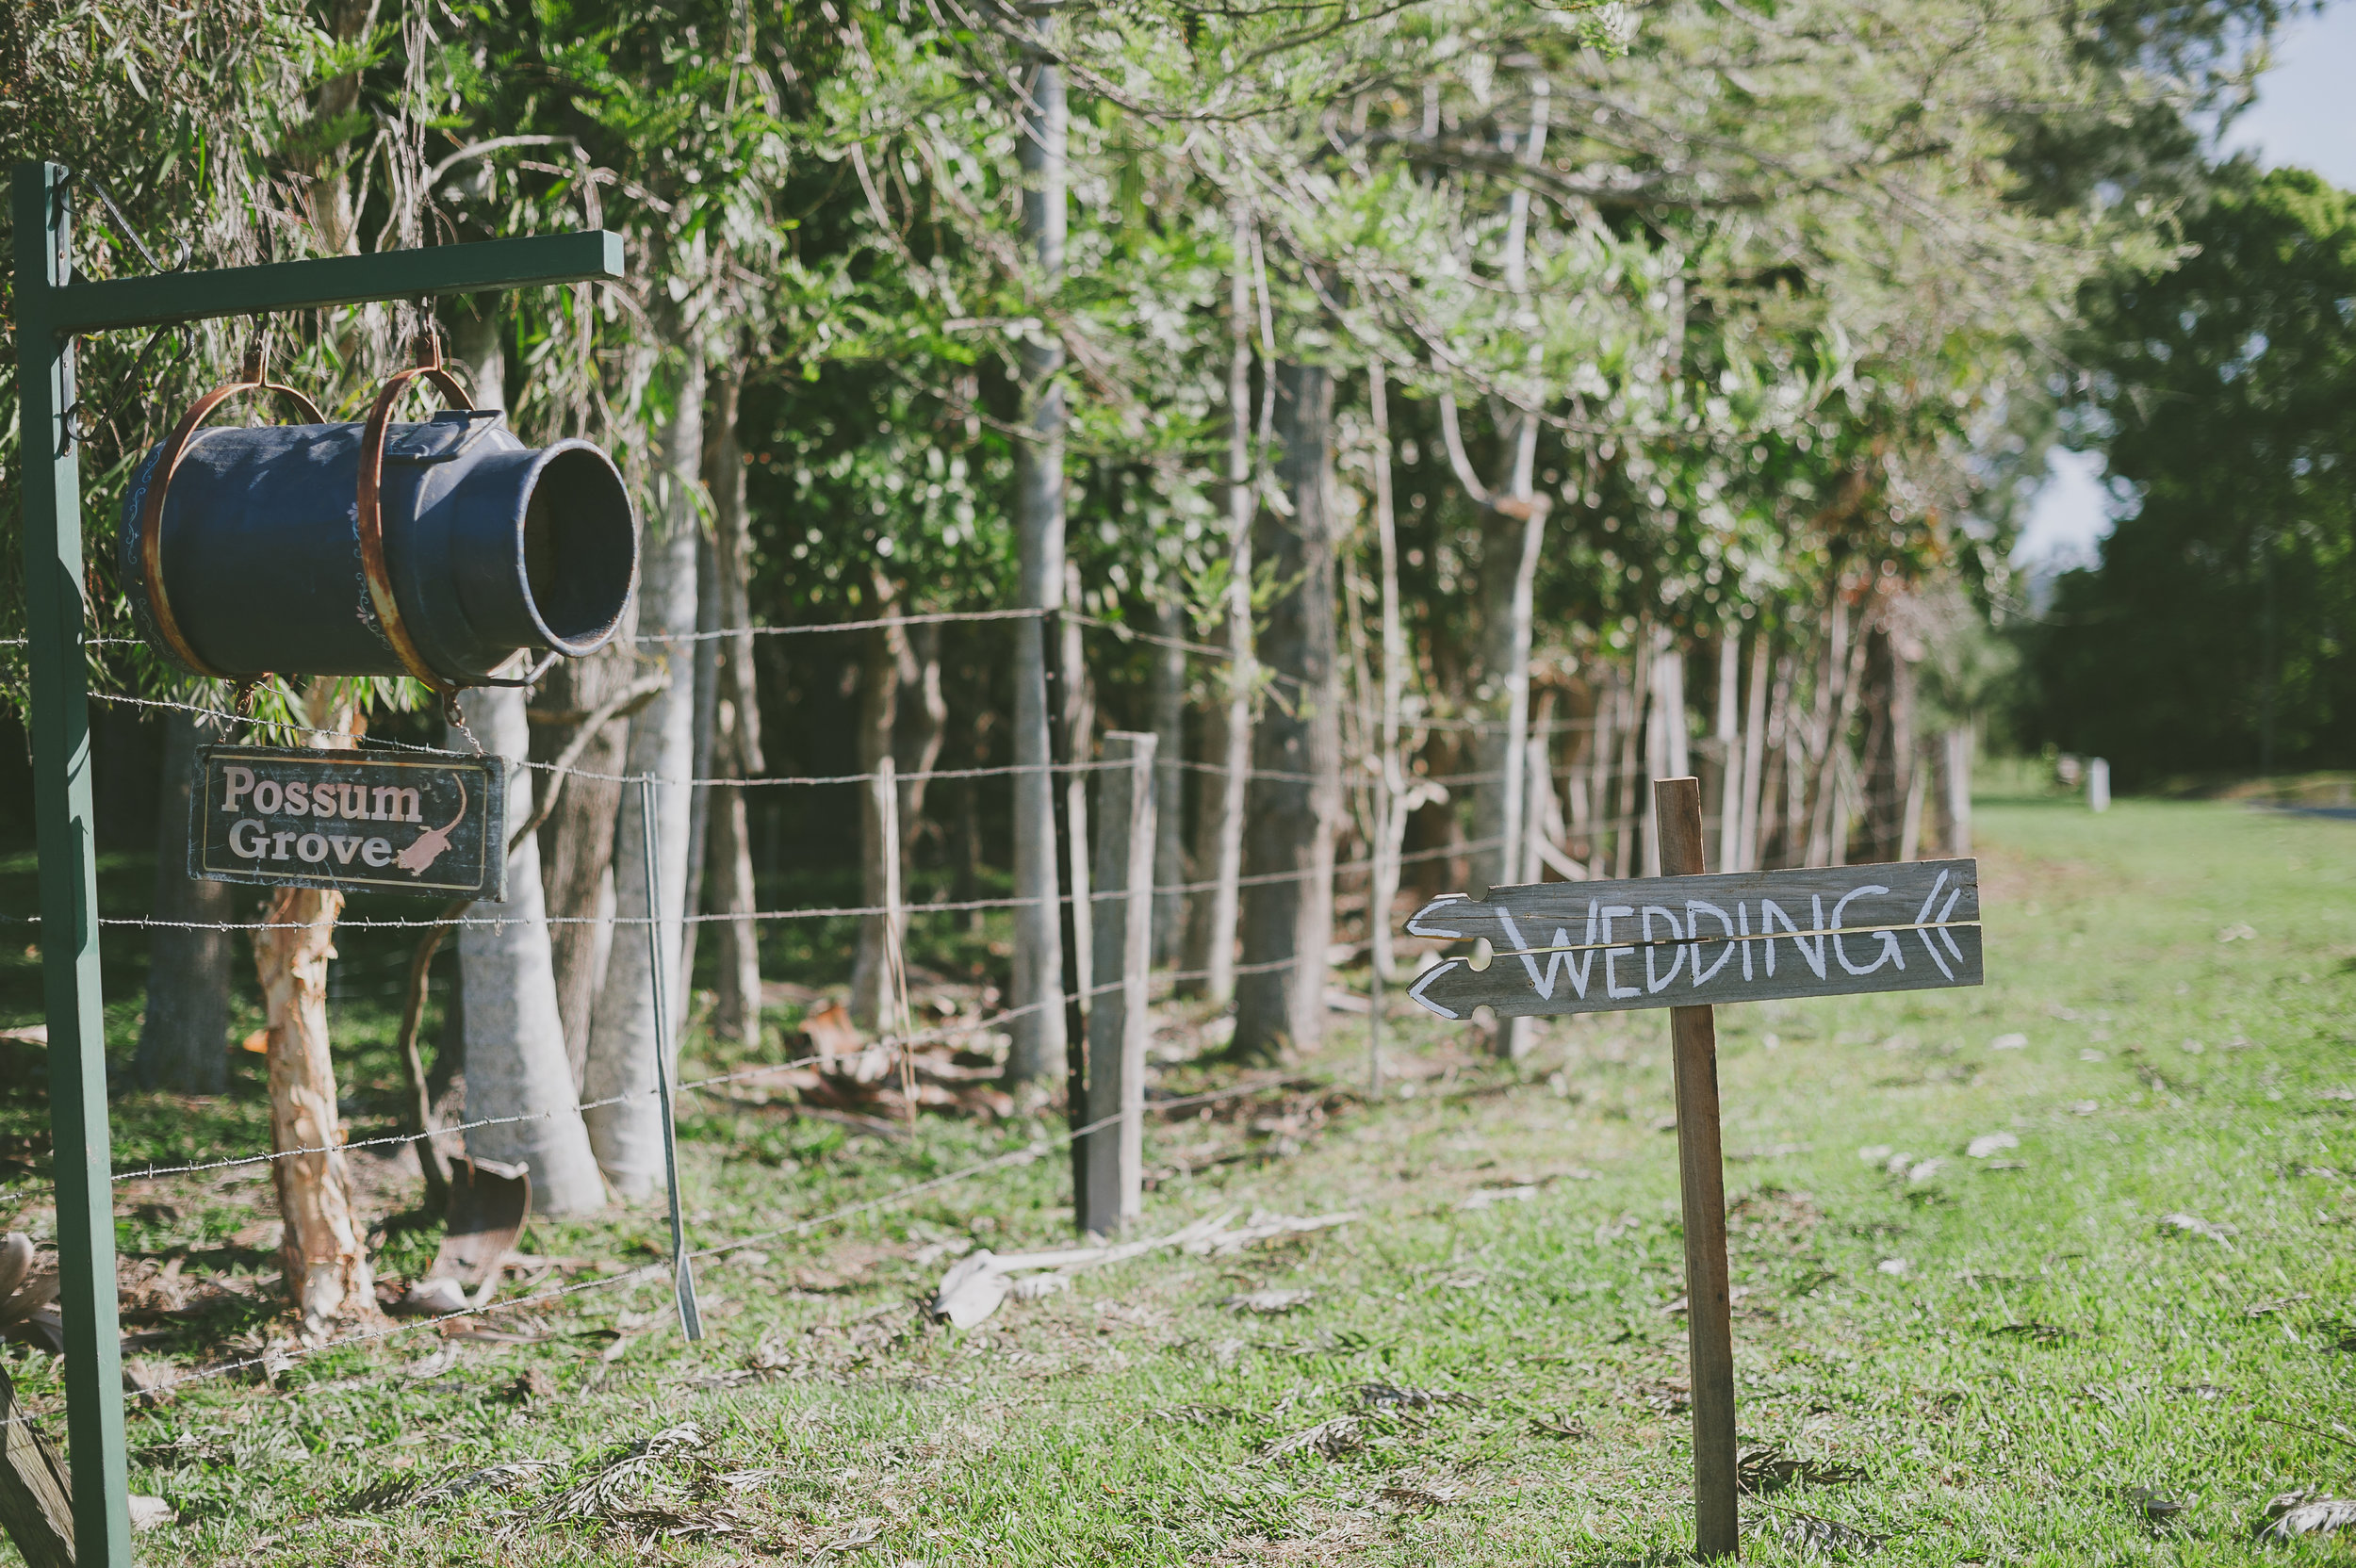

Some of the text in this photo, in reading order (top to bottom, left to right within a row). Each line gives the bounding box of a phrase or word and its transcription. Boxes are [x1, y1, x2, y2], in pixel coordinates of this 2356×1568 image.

[221, 766, 422, 823] Possum
[228, 819, 392, 868] Grove
[1497, 885, 1906, 1001] WEDDING
